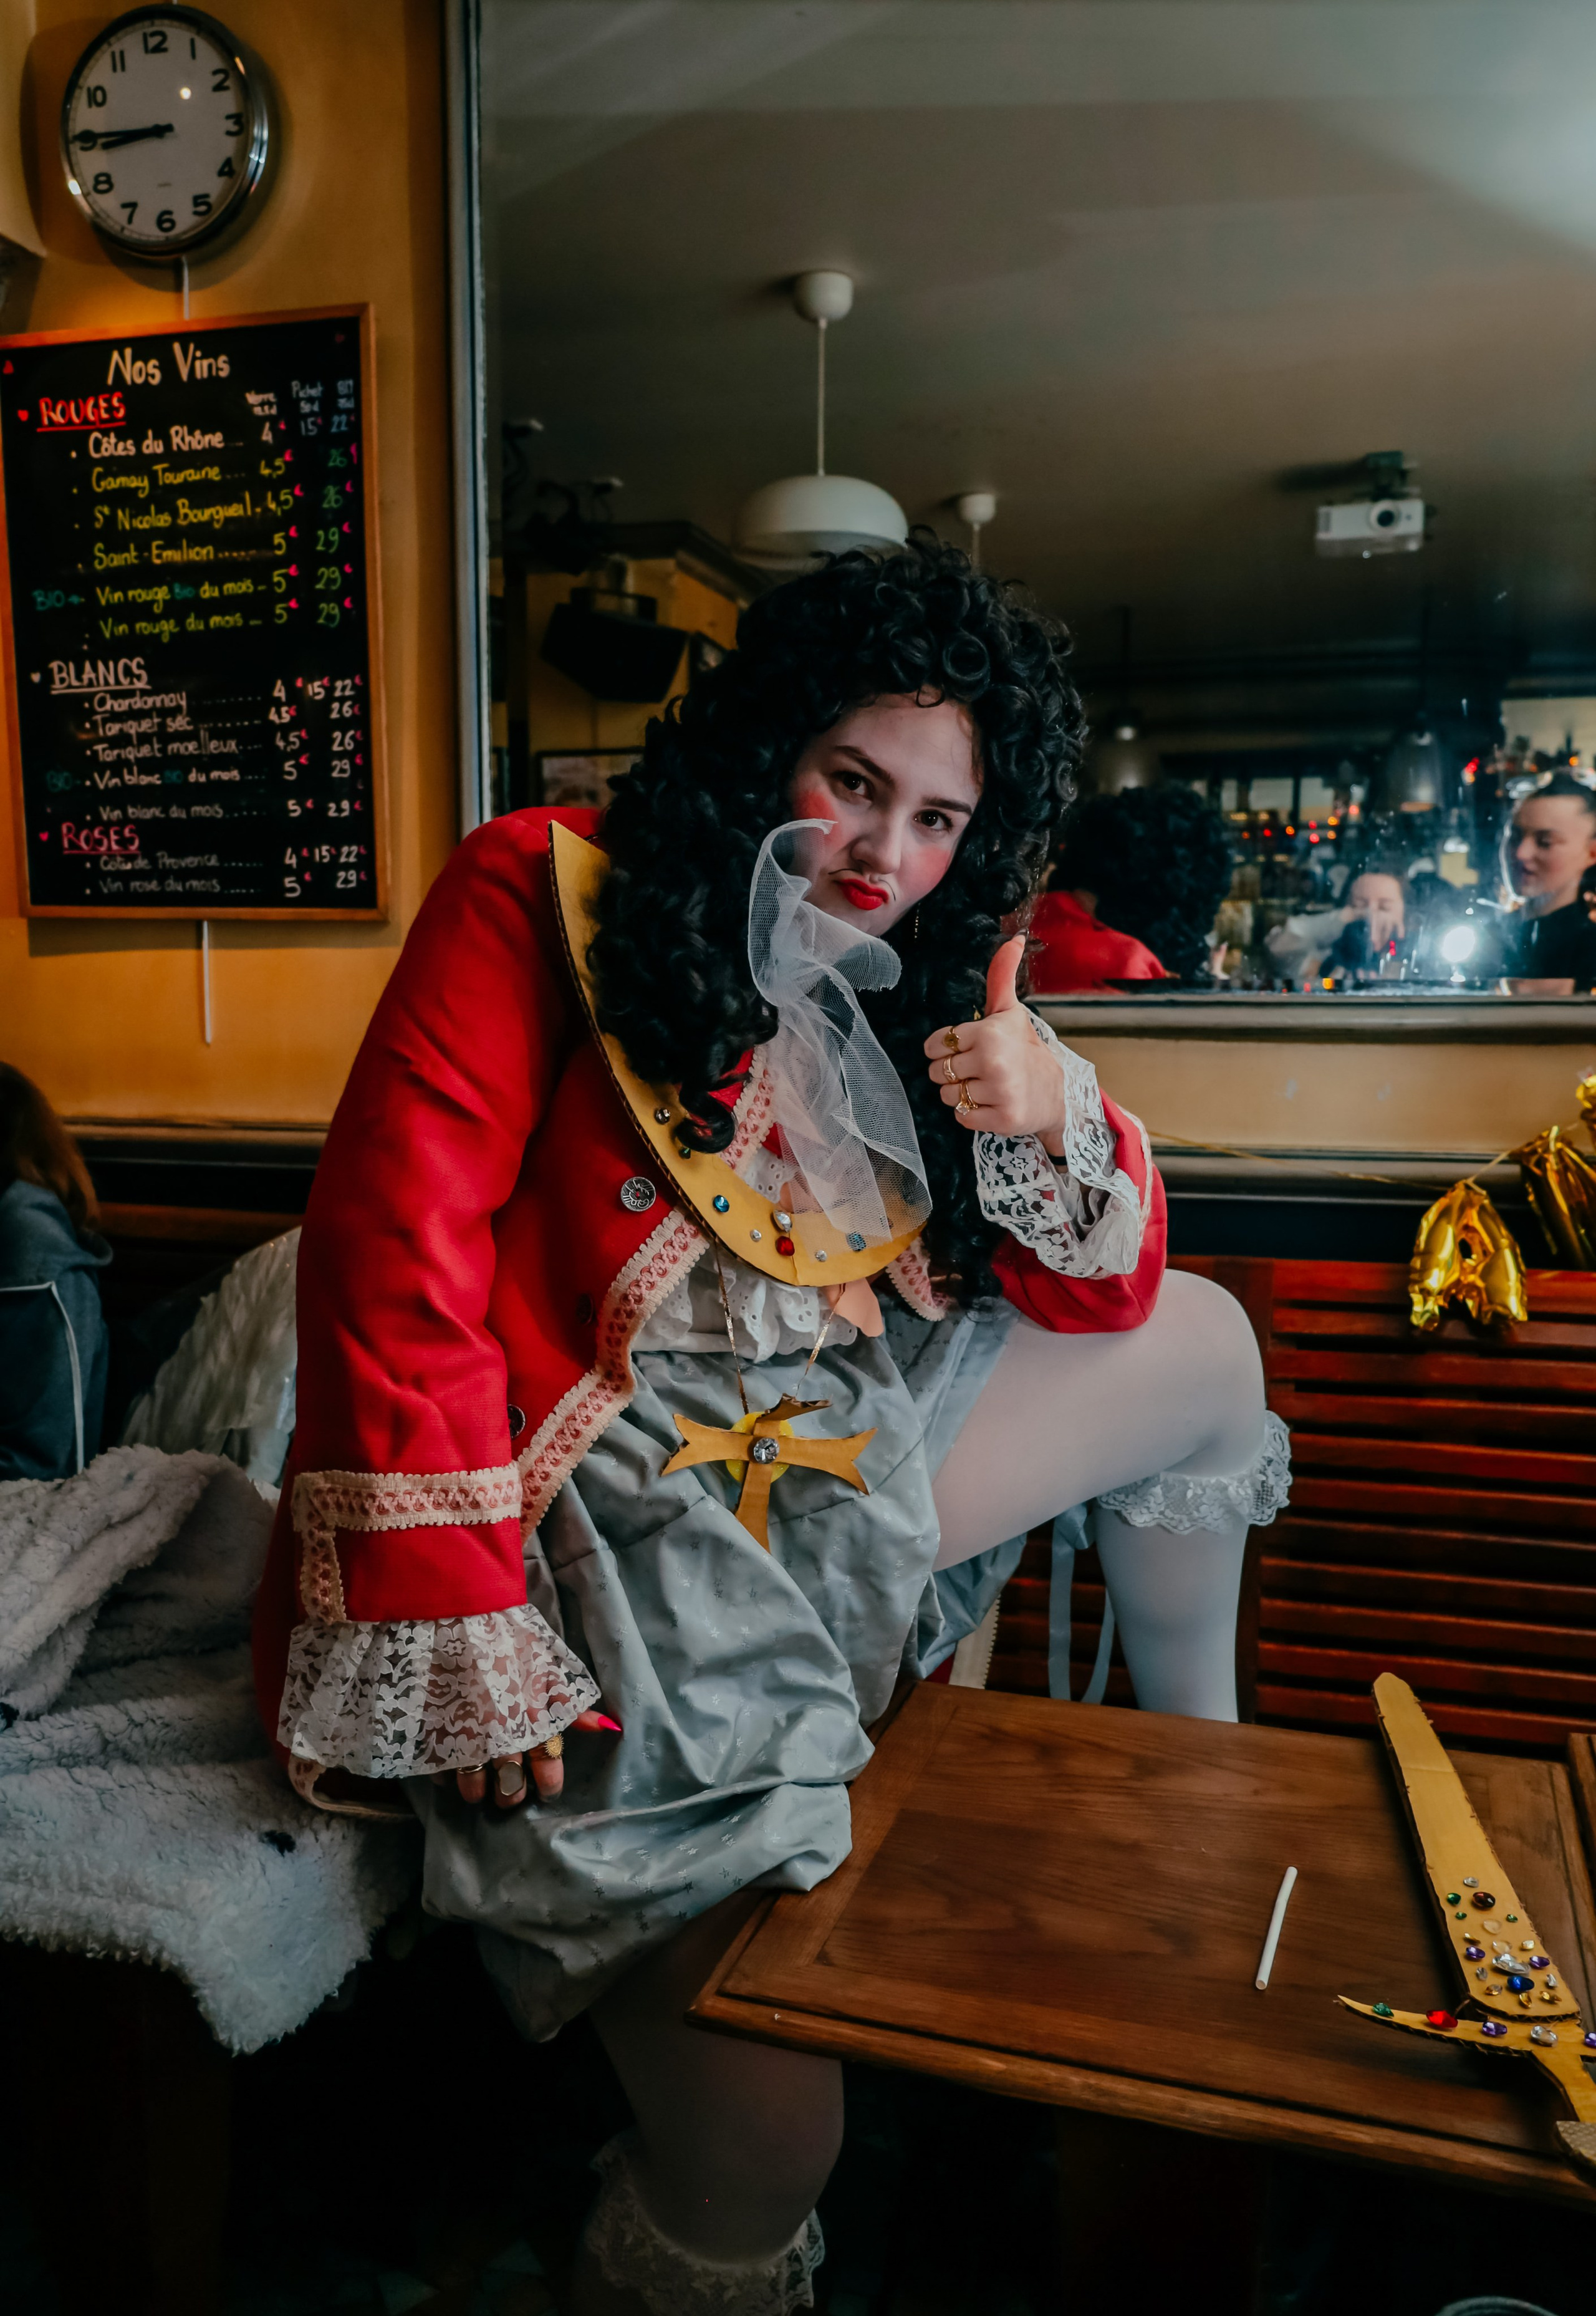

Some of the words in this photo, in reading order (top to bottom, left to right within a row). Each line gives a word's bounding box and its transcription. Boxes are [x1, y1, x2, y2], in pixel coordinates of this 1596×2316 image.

[143, 30, 168, 54] 12
[190, 37, 196, 60] 1
[111, 50, 126, 73] 11
[211, 69, 230, 92] 2
[87, 85, 107, 109] 10
[225, 113, 244, 137] 3
[218, 157, 236, 178] 4
[92, 173, 113, 195] 8
[120, 202, 138, 224] 7
[192, 194, 213, 216] 5
[156, 210, 176, 233] 6
[107, 347, 162, 387] Nos
[173, 341, 230, 383] Vins
[38, 391, 126, 427] ROUGES
[89, 431, 136, 459] Côtes
[142, 427, 165, 455] du
[168, 425, 225, 452] Rhône
[92, 466, 150, 498] Gamay
[151, 463, 221, 486] Touraine
[117, 502, 172, 531] Nicolas
[176, 490, 252, 529] Bourgueil
[31, 588, 66, 612] BIO
[95, 586, 124, 607] Vin
[127, 584, 171, 614] rouge
[200, 580, 220, 599] du
[223, 578, 254, 596] mois
[100, 616, 129, 640] Vin
[135, 618, 180, 644] rouge
[185, 612, 204, 632] du
[208, 612, 243, 629] mois
[47, 657, 149, 688] BLANCS
[94, 690, 187, 716] Chardonnay
[167, 728, 239, 755] moelleux
[94, 770, 122, 790] Vin
[123, 765, 162, 786] blanc
[188, 766, 207, 783] du
[209, 767, 241, 782] mois
[99, 805, 123, 821] Vin
[127, 804, 166, 819] blanc
[169, 804, 186, 819] du
[190, 803, 224, 819] mois
[61, 821, 140, 851] ROSES
[156, 849, 220, 870] Provence
[99, 876, 123, 894] Vin
[163, 875, 183, 892] du
[185, 878, 221, 893] mois
